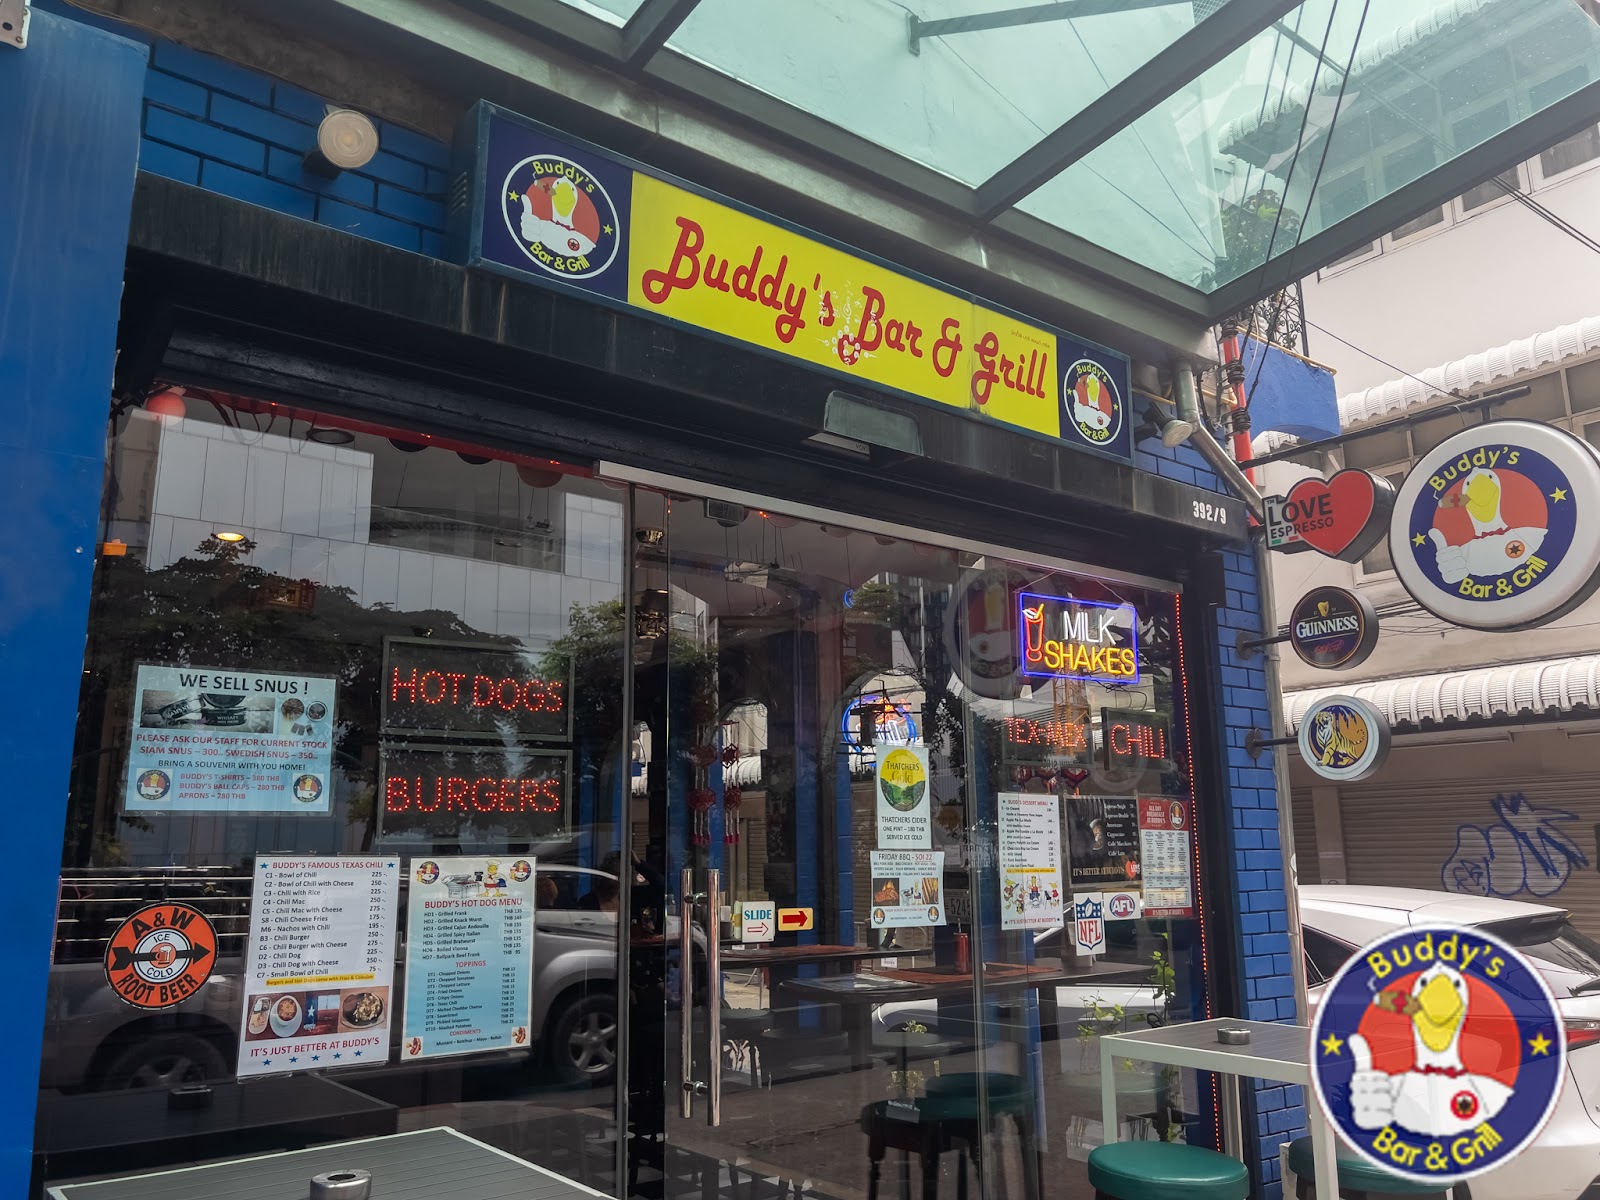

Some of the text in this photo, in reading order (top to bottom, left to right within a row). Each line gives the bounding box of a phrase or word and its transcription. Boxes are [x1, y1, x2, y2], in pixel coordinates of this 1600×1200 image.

[533, 161, 595, 193] Buddy's
[530, 242, 590, 271] Bar & Grill
[641, 215, 1047, 405] Buddy's Bar & Grill
[1076, 364, 1107, 382] Buddy's
[1080, 421, 1092, 436] Bar
[1097, 428, 1110, 440] Grill
[1428, 446, 1520, 492] Buddy's
[1192, 501, 1227, 524] 392/9
[1268, 493, 1333, 527] LOVE
[1271, 517, 1334, 539] ESPRESSO
[1459, 555, 1548, 599] Bar & Grill
[1063, 610, 1116, 645] MILK
[1296, 615, 1359, 638] GUINNESS
[1044, 640, 1136, 675] SHAKES
[180, 673, 208, 688] WE
[213, 676, 249, 691] SELL
[255, 679, 298, 693] SNUS
[392, 666, 563, 712] HOT DOGS
[136, 734, 327, 749] PLEASE ASK OUR STAFF FOR CURRENT STOCK
[1004, 717, 1087, 747] TEX-MEX
[1111, 724, 1165, 758] CHILI
[140, 746, 165, 754] SIAM
[168, 747, 192, 755] SNUS
[226, 749, 265, 757] SWEDISH
[195, 761, 236, 769] SOUVENIR
[886, 761, 919, 771] THATCHERS
[387, 776, 560, 812] BURGERS
[425, 900, 459, 909] BUDDY'S
[480, 899, 496, 907] DOG
[499, 898, 522, 906] MENU
[744, 909, 772, 920] SLIDE
[1112, 900, 1134, 912] AFL
[153, 933, 171, 943] ICE
[1079, 919, 1101, 943] NFL
[146, 967, 173, 978] COLD
[456, 960, 486, 968] TOPPINGS
[116, 972, 199, 1003] ROOT BEER
[450, 1028, 481, 1036] CONDIMENTS
[250, 1037, 380, 1057] IT'S JUST BETTER AT BUDDY'S
